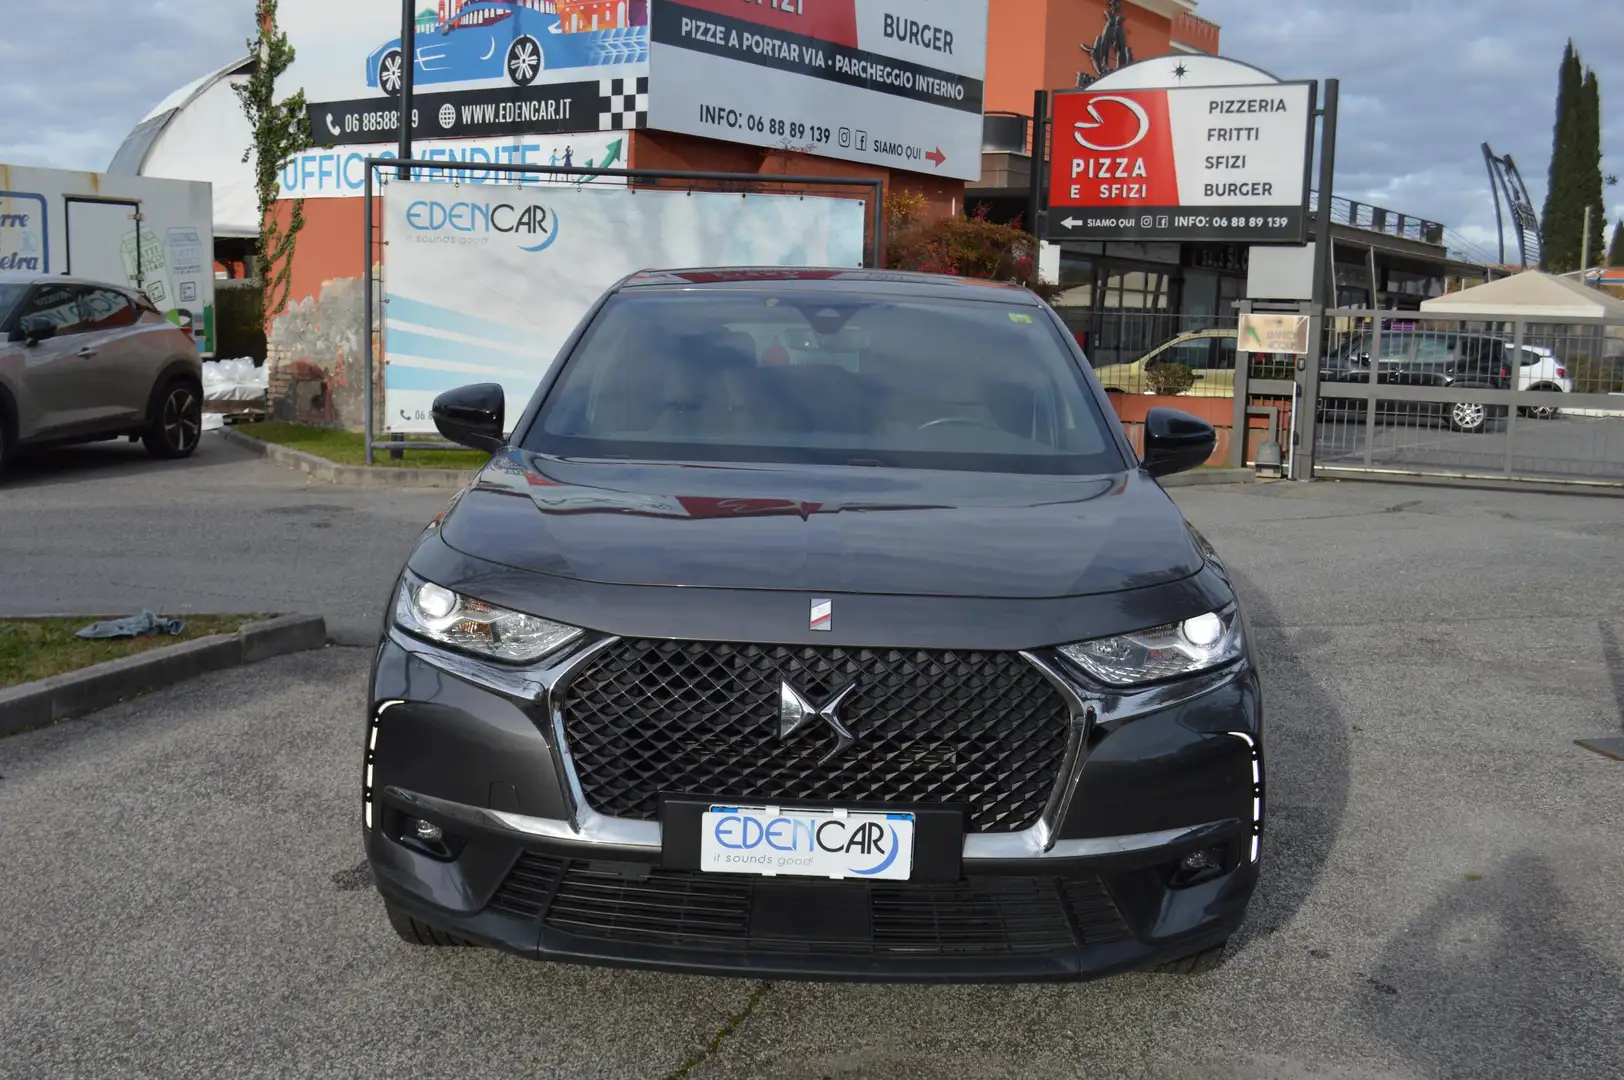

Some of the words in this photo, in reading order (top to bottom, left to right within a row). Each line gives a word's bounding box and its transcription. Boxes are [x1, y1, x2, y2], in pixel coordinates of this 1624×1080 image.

[884, 13, 954, 55] BURGER
[681, 17, 725, 45] PIZZE
[728, 29, 739, 49] A
[743, 32, 799, 63] PORTAR
[802, 46, 825, 68] VIA
[836, 54, 913, 88] PARCHEGGIO
[915, 74, 965, 101] INTERNO
[345, 113, 360, 133] 06
[362, 108, 419, 132] 885889
[461, 98, 572, 125] WWW.EDENCAR.IT
[1208, 98, 1288, 114] PIZZERIA
[699, 103, 743, 129] INFO:
[747, 114, 764, 133] 06
[769, 118, 785, 137] 88
[789, 122, 805, 140] 89
[809, 125, 831, 144] 139
[873, 139, 904, 157] SIAMO
[905, 146, 922, 161] QUI
[1206, 127, 1260, 142] FRITTI
[410, 144, 541, 185] VENDITE
[1070, 157, 1148, 179] PIZZA
[1204, 155, 1247, 170] SFIZI
[1070, 184, 1081, 199] E
[1099, 184, 1148, 199] SFIZI
[1203, 182, 1273, 197] BURGER
[406, 200, 548, 234] EDENCAR
[1087, 218, 1117, 228] SIAMO
[1118, 219, 1135, 229] QUI
[1174, 215, 1210, 228] INFO:
[1212, 216, 1228, 228] 06
[1231, 216, 1246, 228] 88
[1248, 216, 1264, 228] 89
[1267, 216, 1288, 228] 139
[416, 235, 456, 244] sounds
[714, 815, 886, 855] EDENCAR
[713, 852, 721, 863] it
[725, 854, 773, 865] sounds
